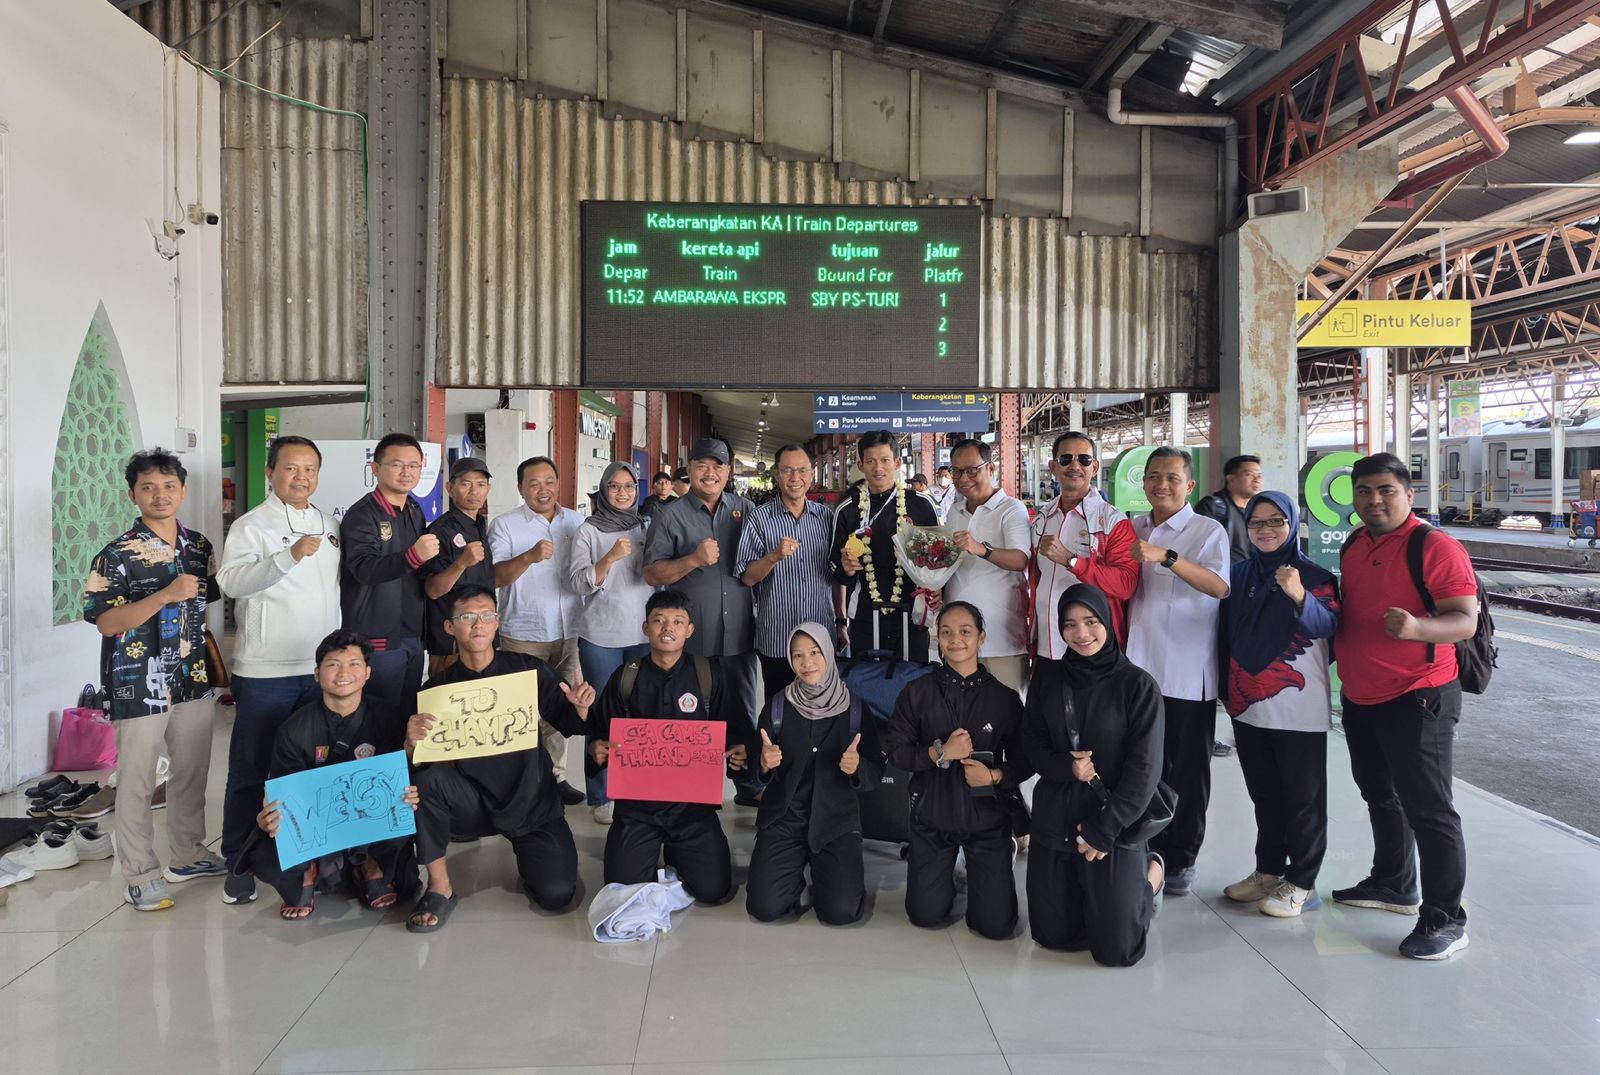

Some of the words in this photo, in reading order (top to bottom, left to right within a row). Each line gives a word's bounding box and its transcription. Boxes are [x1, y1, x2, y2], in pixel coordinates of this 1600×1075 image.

[647, 213, 756, 232] Keberangkatan
[761, 215, 783, 231] KA
[795, 216, 832, 231] Train
[836, 216, 919, 234] Departures
[607, 238, 638, 258] jam
[681, 240, 734, 256] kereta
[736, 241, 760, 260] api
[831, 242, 879, 261] tujuan
[924, 242, 960, 262] jalur
[603, 263, 648, 283] Depar
[702, 265, 738, 281] Train
[818, 267, 865, 282] Bound
[869, 267, 894, 282] For
[924, 267, 964, 283] Platfr
[607, 288, 645, 304] 11:52
[652, 289, 739, 304] AMBARAWA
[743, 290, 787, 305] EKSPR
[811, 291, 839, 307] SBY
[841, 291, 899, 307] PS-TURI
[938, 292, 947, 307] 1
[937, 317, 947, 332] 2
[1362, 313, 1404, 328] Pintu
[1410, 313, 1462, 328] Keluar
[1363, 329, 1380, 338] Exit
[937, 341, 947, 356] 3
[906, 416, 927, 424] Ruang
[928, 415, 961, 424] Menyusui
[449, 686, 499, 716] TO
[623, 722, 657, 746] SEA
